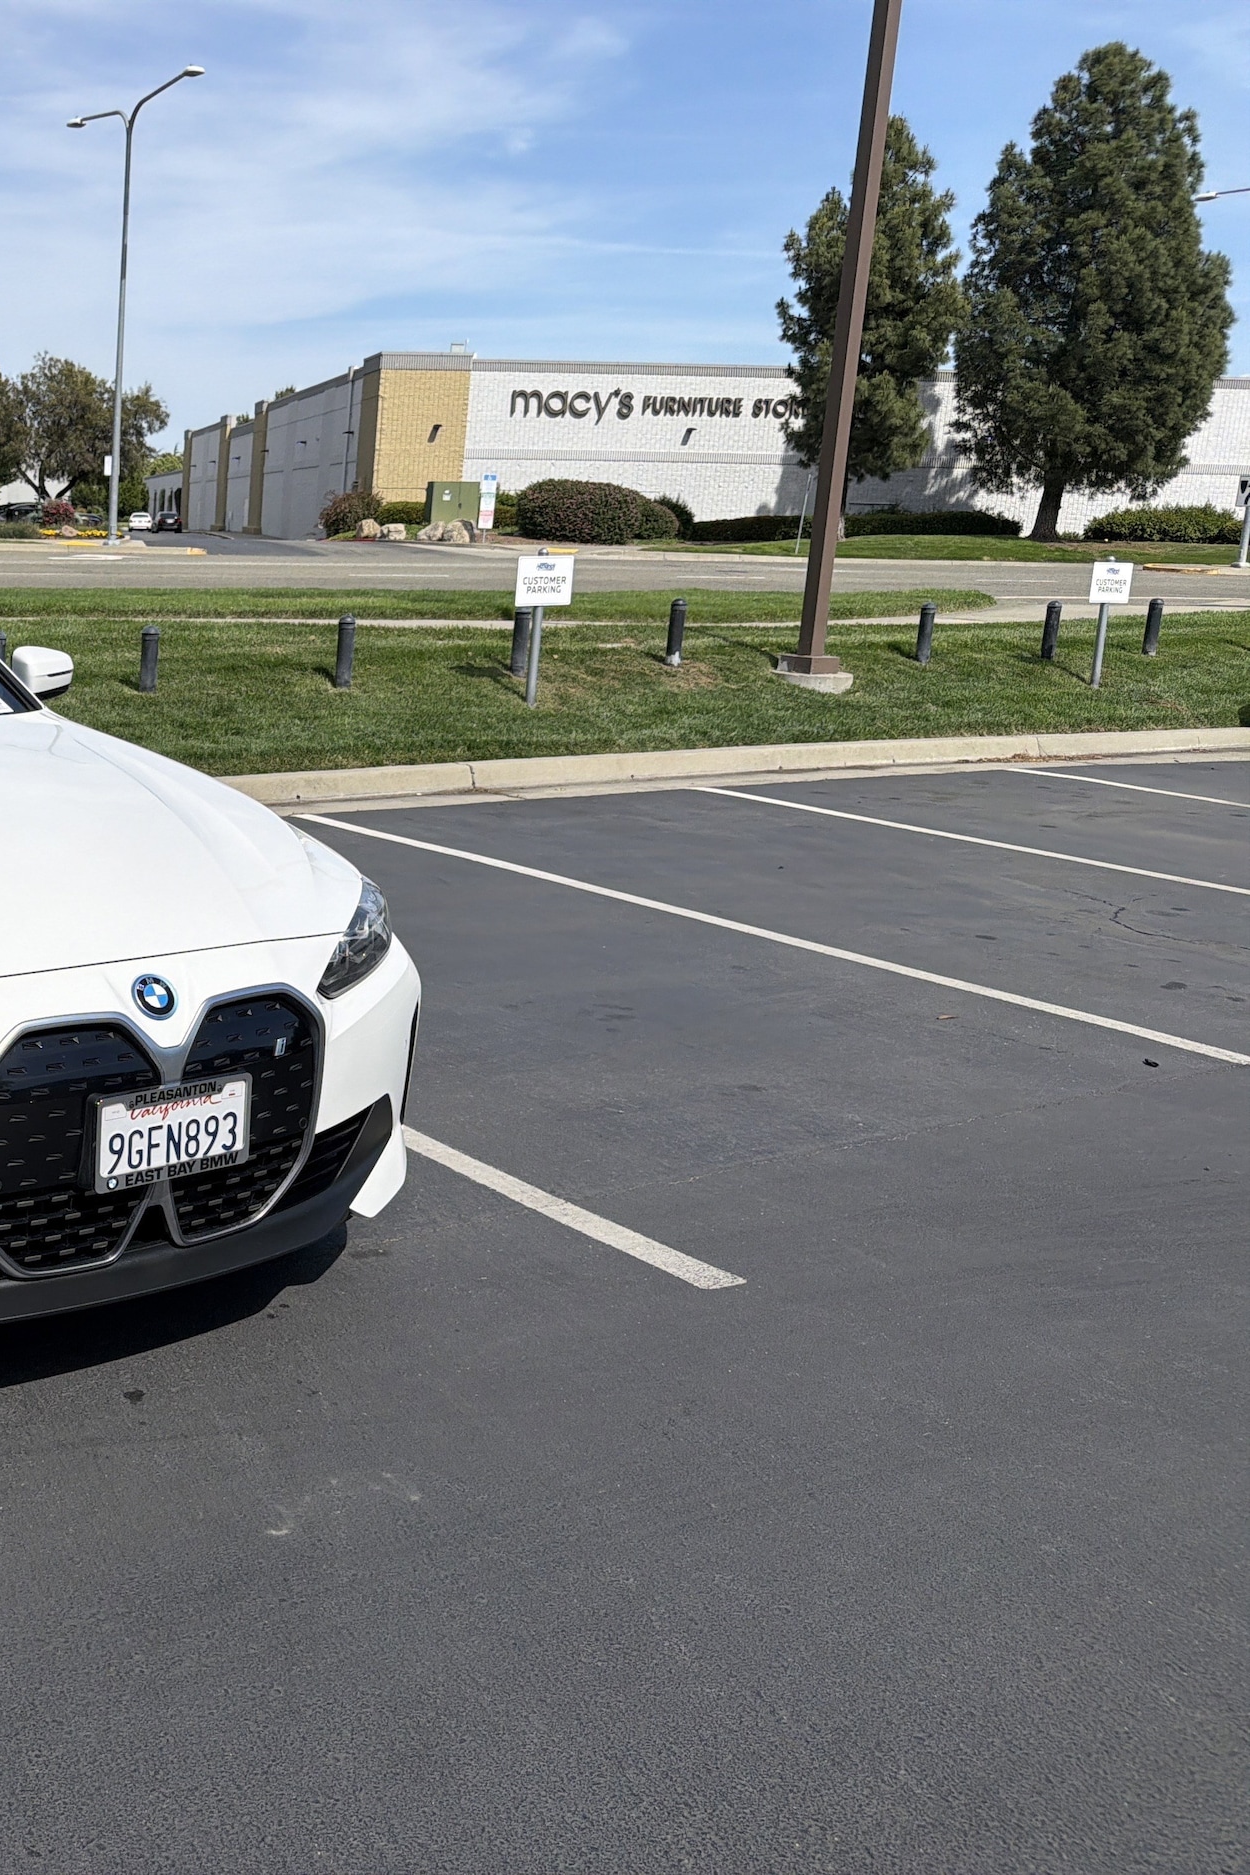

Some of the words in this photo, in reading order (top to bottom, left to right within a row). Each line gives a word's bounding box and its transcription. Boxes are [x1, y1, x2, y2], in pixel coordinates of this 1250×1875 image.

[510, 387, 635, 426] macy's
[641, 395, 744, 418] FURNITURE
[522, 576, 567, 585] CUSTOMER
[526, 585, 561, 594] PARKING
[1095, 578, 1127, 586] CUSTOMER
[134, 1081, 217, 1107] PLEASANTON
[130, 1094, 222, 1121] California
[107, 1111, 238, 1175] 9GFN893
[125, 1169, 161, 1187] EAST
[167, 1161, 197, 1178] BAY
[200, 1152, 239, 1171] BMW
